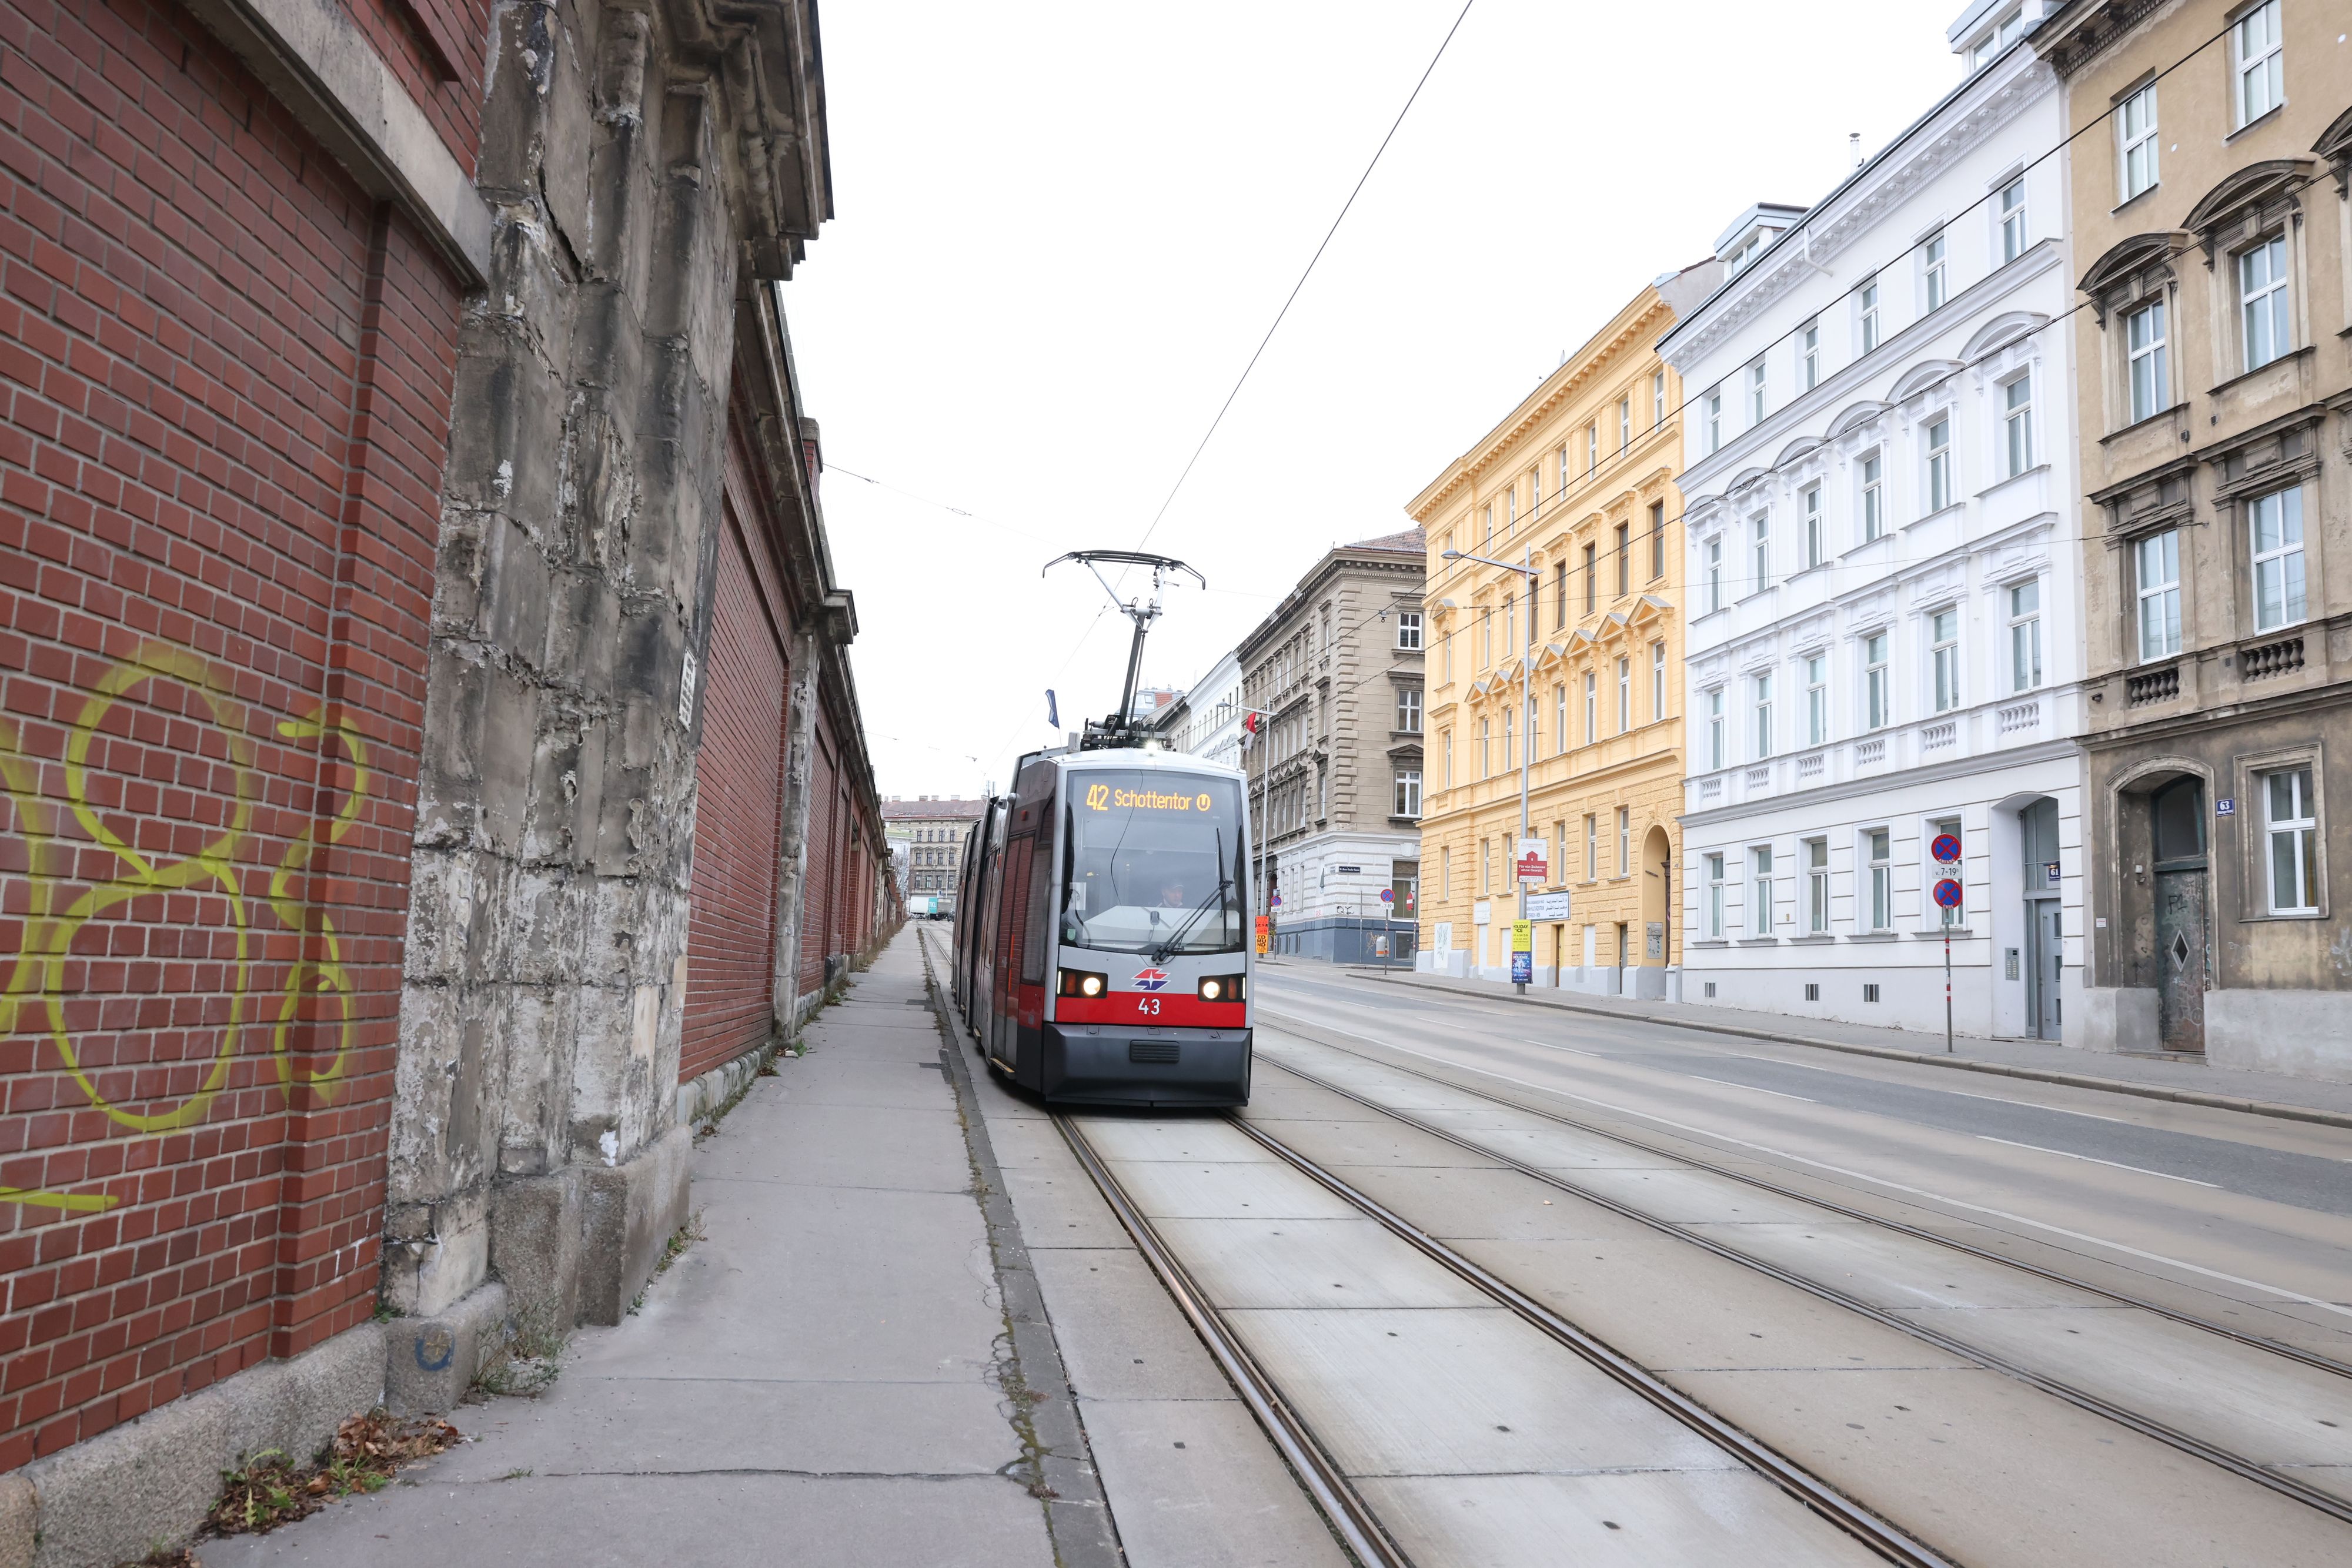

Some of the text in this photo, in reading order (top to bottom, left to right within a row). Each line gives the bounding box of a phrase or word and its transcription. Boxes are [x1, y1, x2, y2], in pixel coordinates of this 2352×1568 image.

[1086, 784, 1109, 811] 42
[1114, 788, 1192, 811] Schottentor
[2220, 800, 2230, 810] 63
[1138, 998, 1161, 1015] 43
